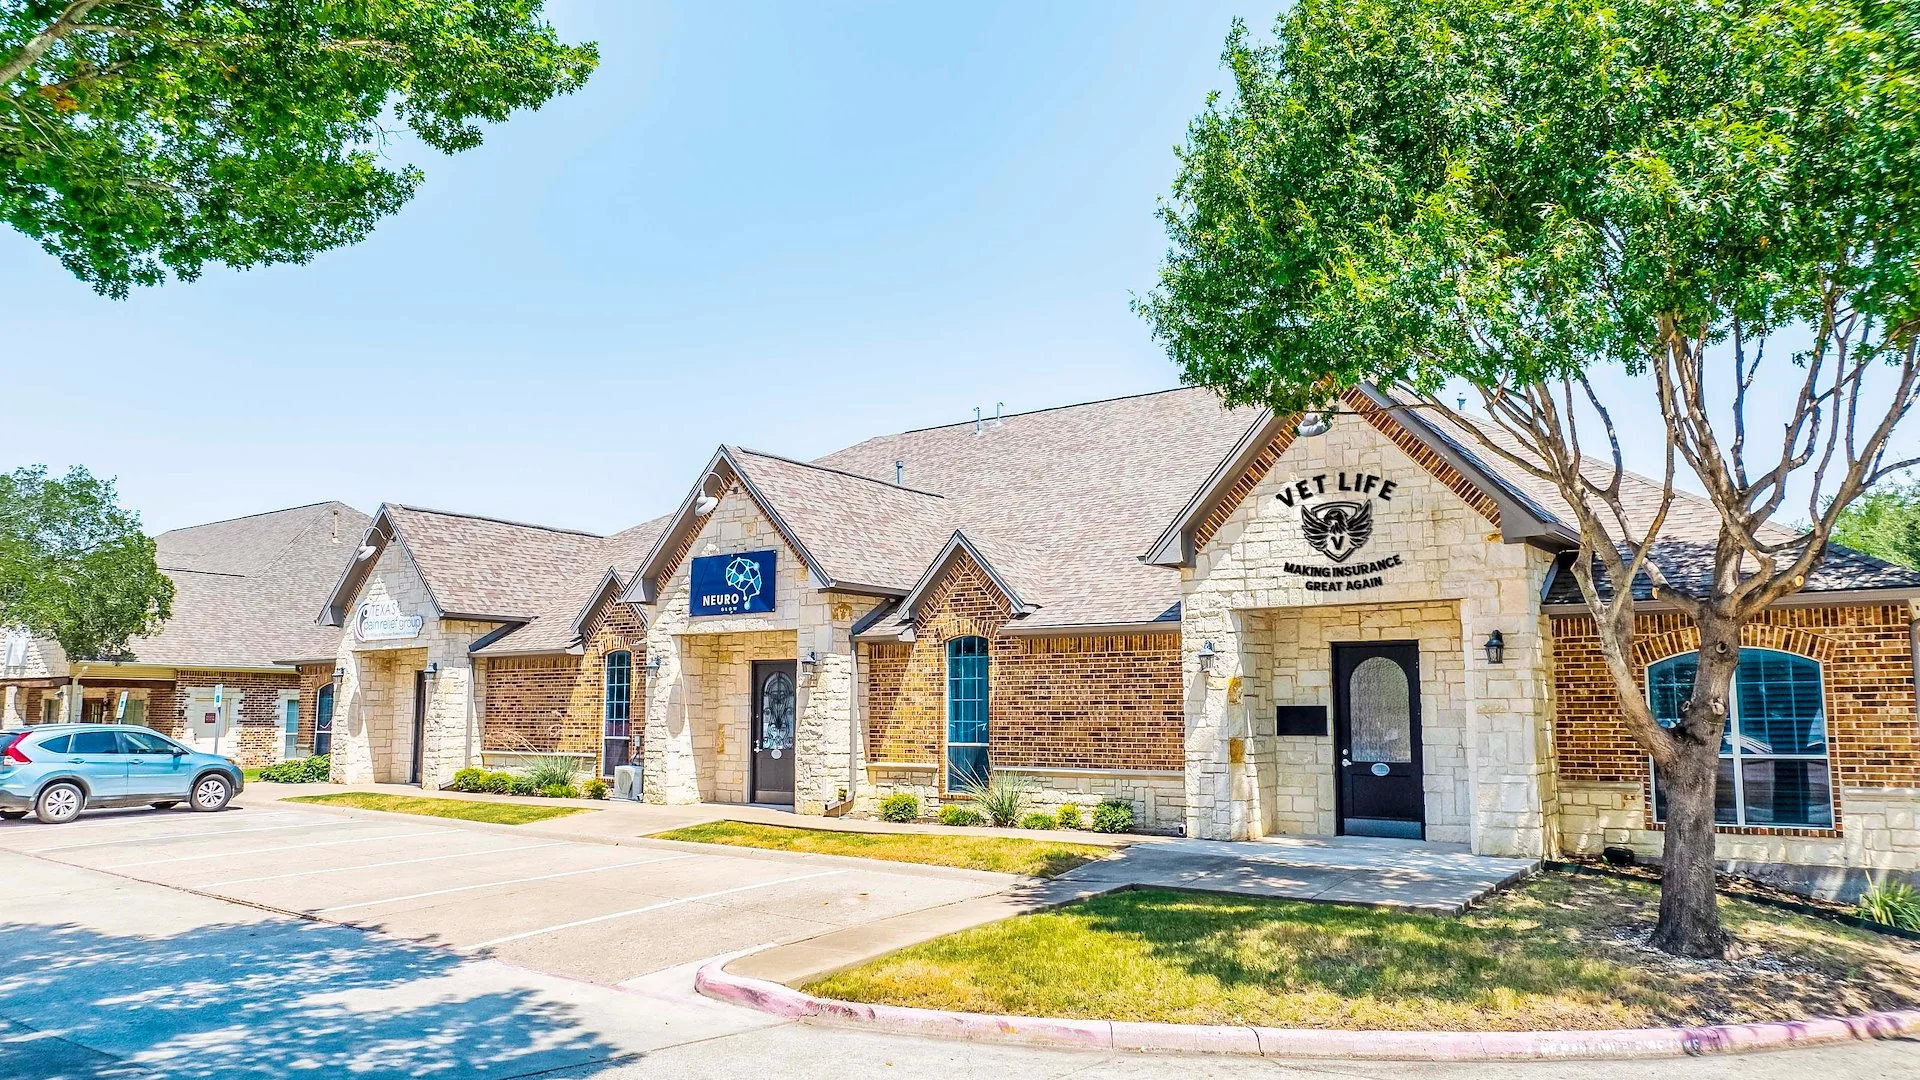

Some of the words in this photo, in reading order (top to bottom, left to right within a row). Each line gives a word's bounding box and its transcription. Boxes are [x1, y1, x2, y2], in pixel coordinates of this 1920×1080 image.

[1276, 474, 1326, 507] VET
[1339, 472, 1398, 501] LIFE
[1331, 536, 1344, 550] V
[1284, 562, 1331, 577] MAKING
[1332, 555, 1403, 577] INSURANCE
[1305, 581, 1343, 591] GREAT
[1346, 577, 1383, 591] AGAIN
[702, 593, 739, 606] NEURO
[371, 602, 396, 617] TEXAS
